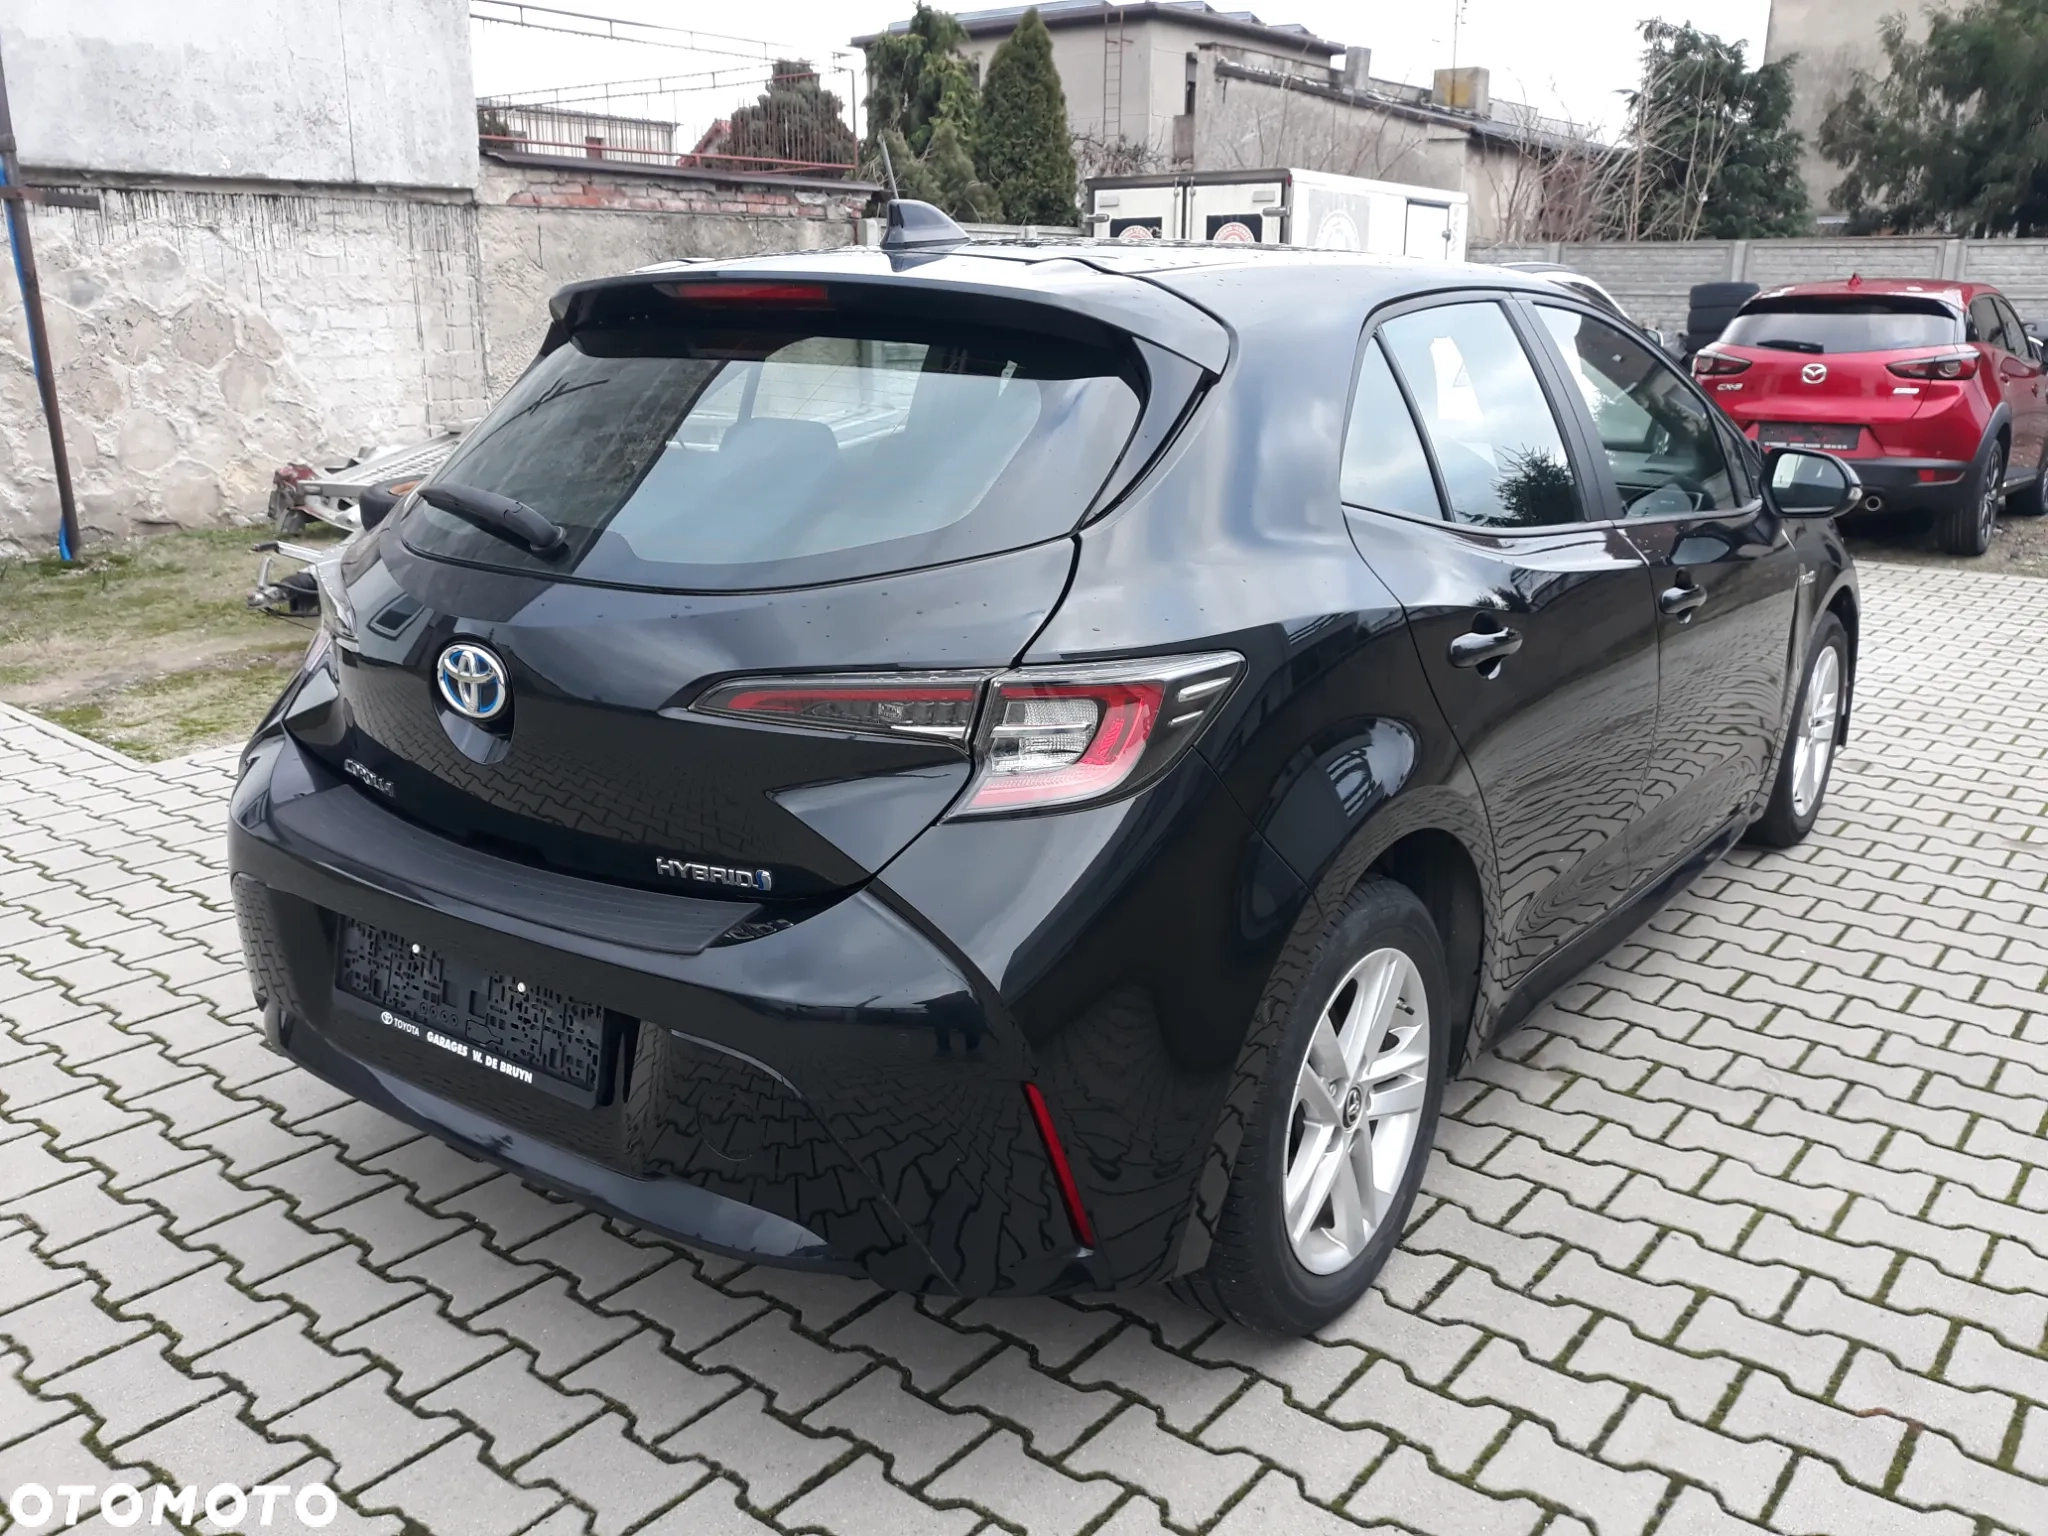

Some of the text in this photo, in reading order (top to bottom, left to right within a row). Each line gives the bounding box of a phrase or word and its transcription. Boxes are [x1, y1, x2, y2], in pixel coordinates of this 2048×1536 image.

[656, 856, 753, 888] HYBRID
[393, 1017, 533, 1084] TOYOTA GARAGES W. DE BRUYN
